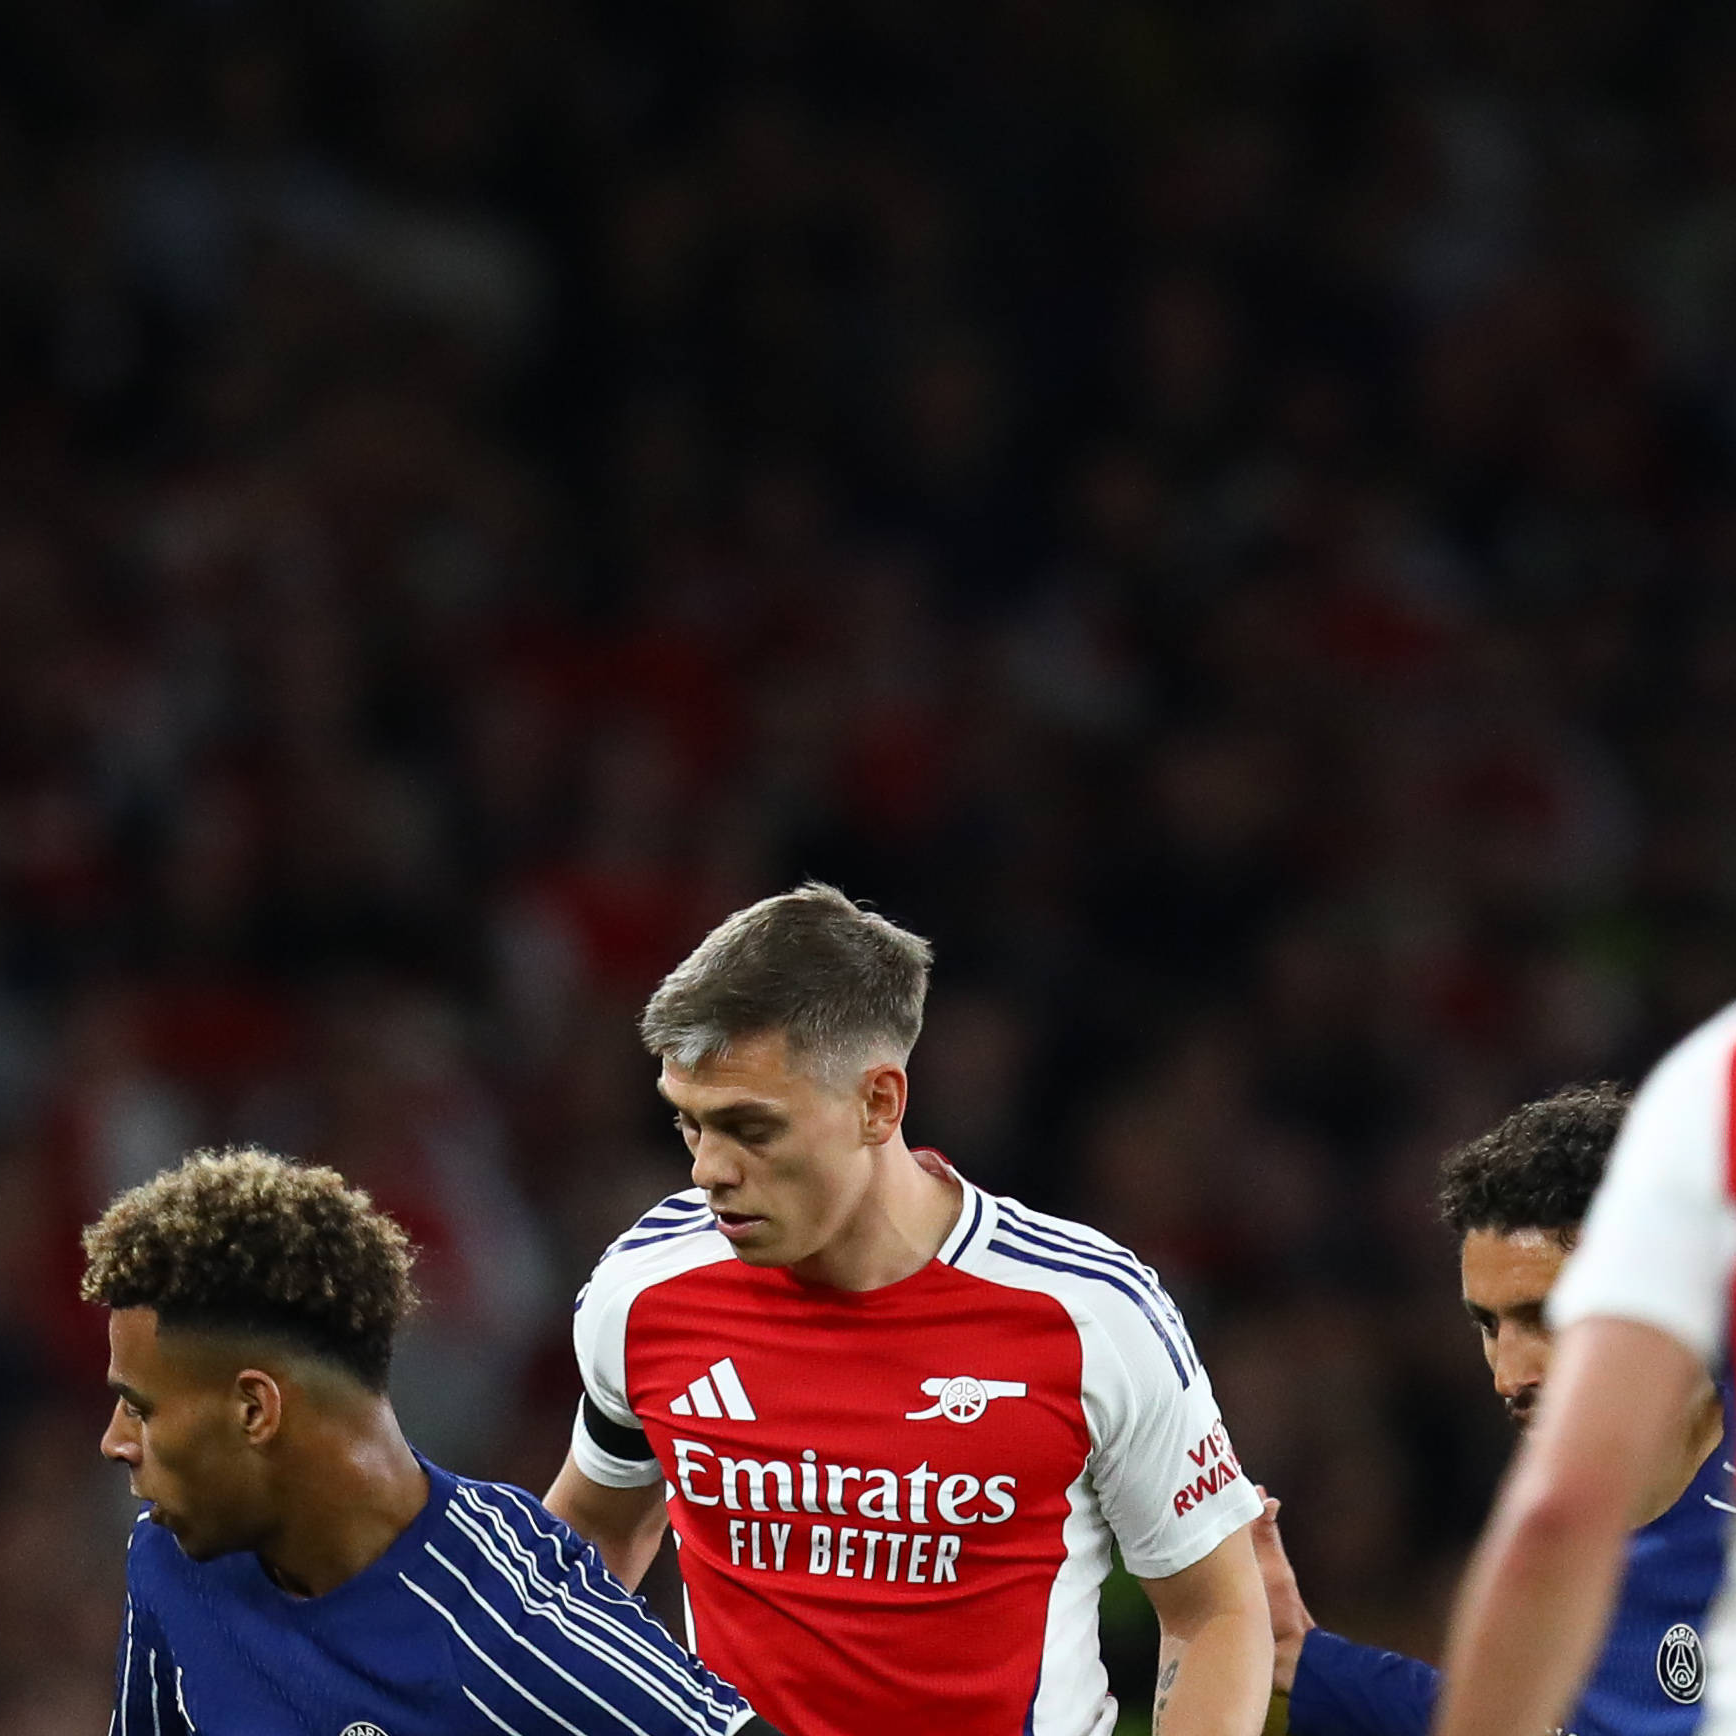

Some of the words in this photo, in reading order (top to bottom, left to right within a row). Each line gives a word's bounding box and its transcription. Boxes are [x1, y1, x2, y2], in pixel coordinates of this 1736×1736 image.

[1187, 1418, 1226, 1467] VIS
[671, 1438, 1017, 1525] Emirates
[1173, 1447, 1242, 1517] RWA
[729, 1519, 792, 1571] FLY
[809, 1525, 961, 1584] BETTER
